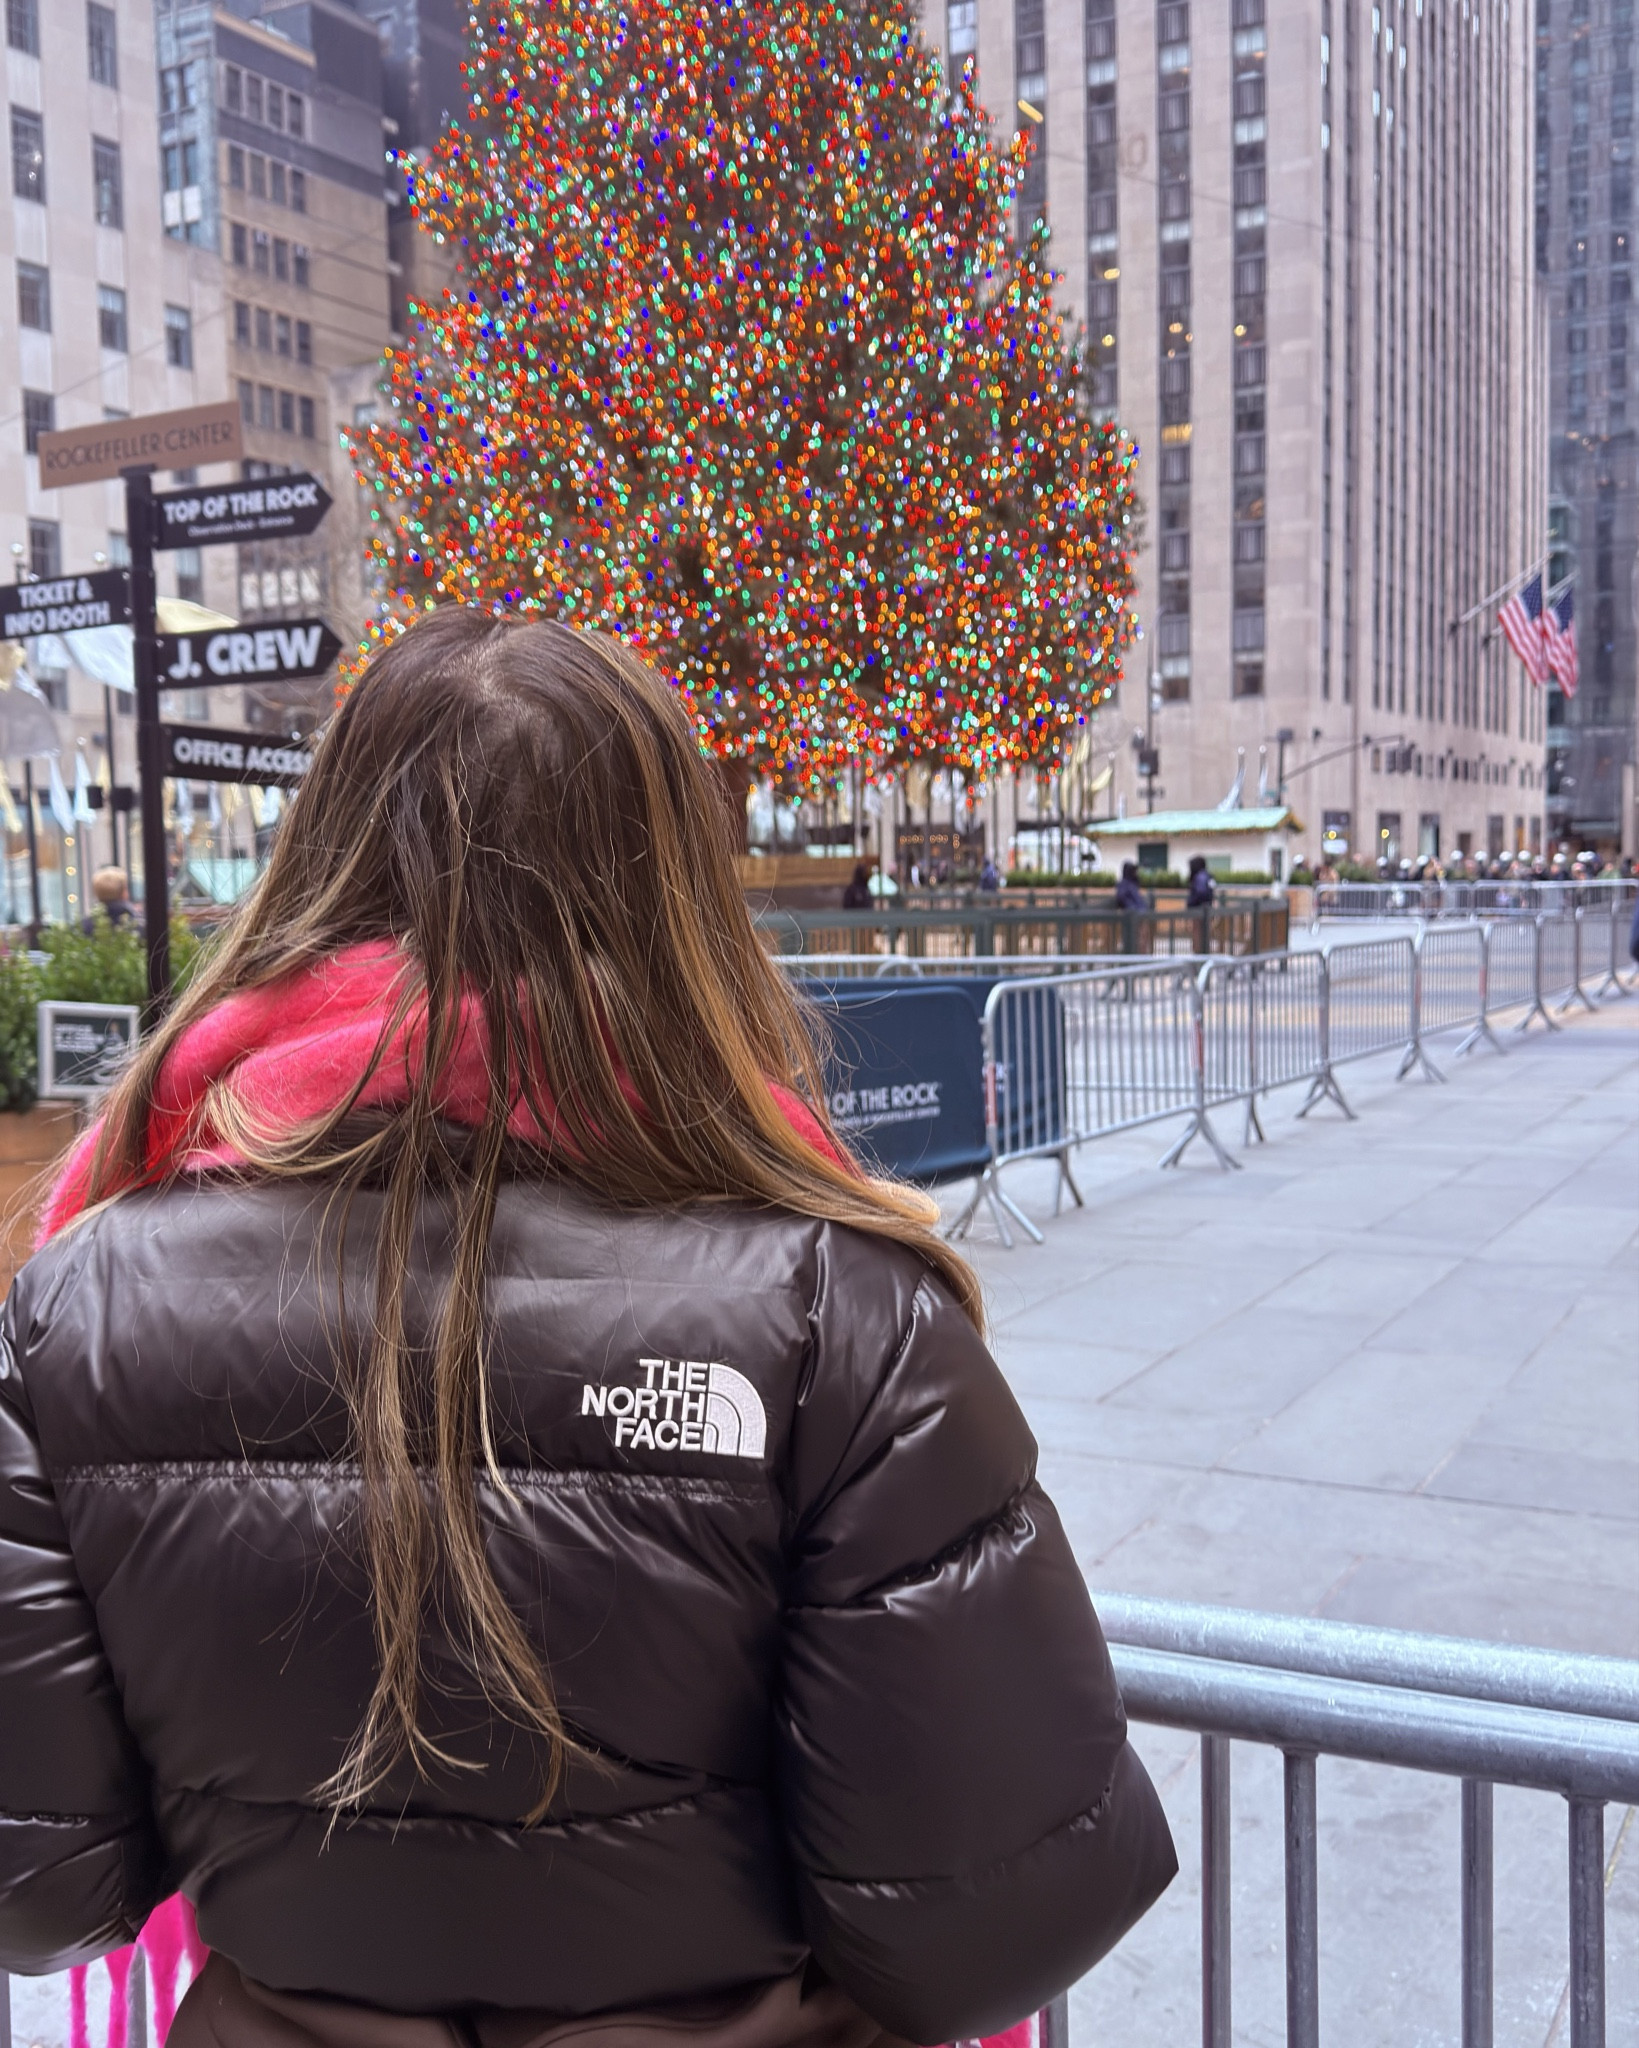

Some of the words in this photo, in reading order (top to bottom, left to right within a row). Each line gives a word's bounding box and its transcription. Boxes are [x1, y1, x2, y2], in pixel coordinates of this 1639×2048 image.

[46, 431, 160, 469] ROCKEFELLER
[164, 420, 233, 451] CENTER
[163, 499, 200, 524] TOP
[202, 494, 228, 519] OF
[229, 490, 264, 515] THE
[265, 482, 318, 512] ROCK
[18, 580, 76, 608] TICKET
[77, 577, 94, 601] &
[4, 610, 45, 637] INFO
[46, 600, 111, 631] BOOTH
[168, 638, 202, 680] J.
[206, 625, 322, 676] CREW
[174, 736, 243, 769] OFFICE
[832, 1091, 856, 1116] OF
[860, 1086, 889, 1112] THE
[891, 1081, 940, 1108] ROCK
[639, 1358, 708, 1392] THE
[581, 1384, 705, 1422] NORTH
[614, 1417, 703, 1450] FACE
